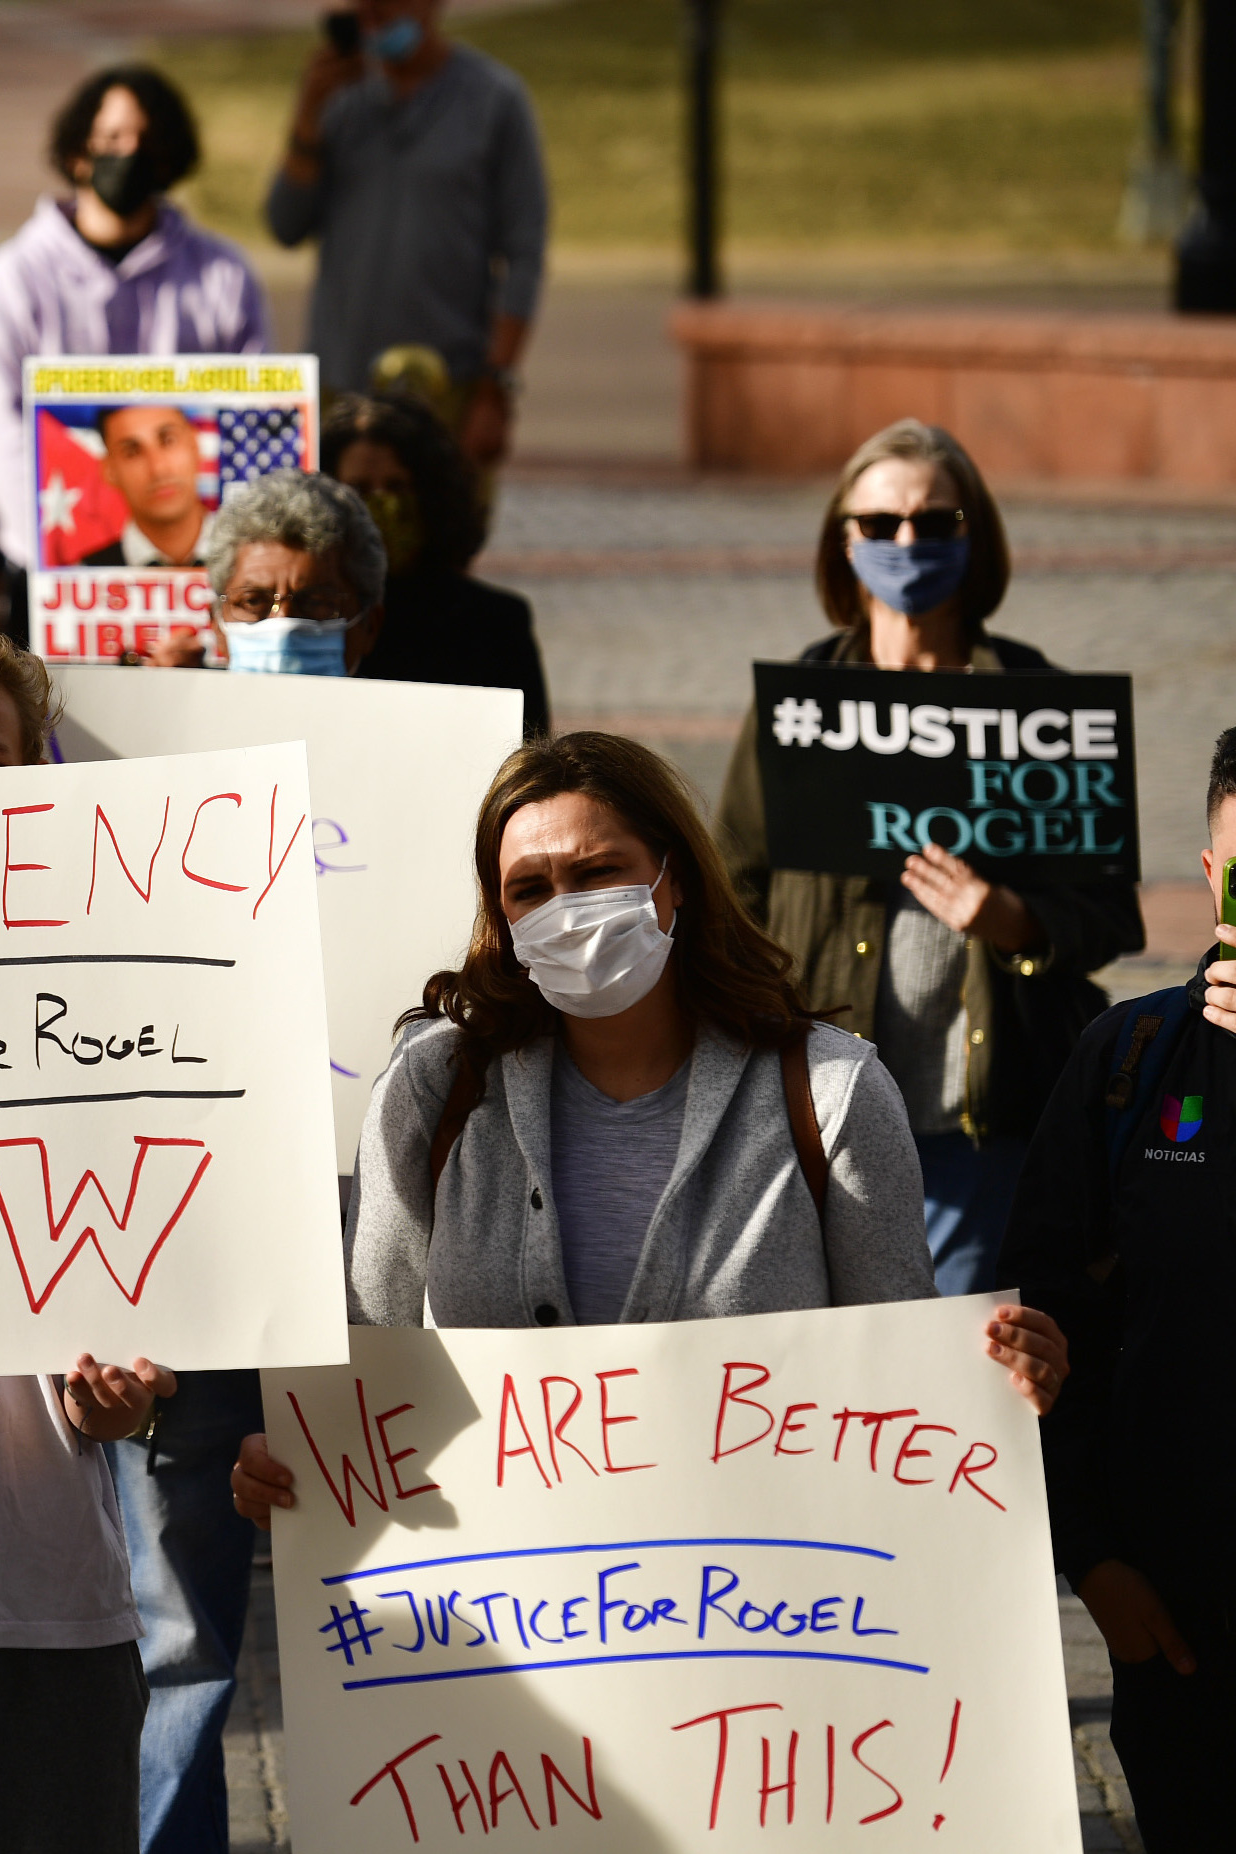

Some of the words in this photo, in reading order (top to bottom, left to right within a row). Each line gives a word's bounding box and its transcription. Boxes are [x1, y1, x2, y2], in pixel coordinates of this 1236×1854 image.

[773, 698, 1119, 760] #JUSTICE
[967, 759, 1125, 808] FOR
[866, 801, 1125, 857] ROGEL
[1145, 1148, 1205, 1163] NOTICIAS
[287, 1380, 441, 1528] WE
[497, 1368, 656, 1488] ARE
[349, 1734, 602, 1842] THAN
[672, 1699, 962, 1831] THIS!
